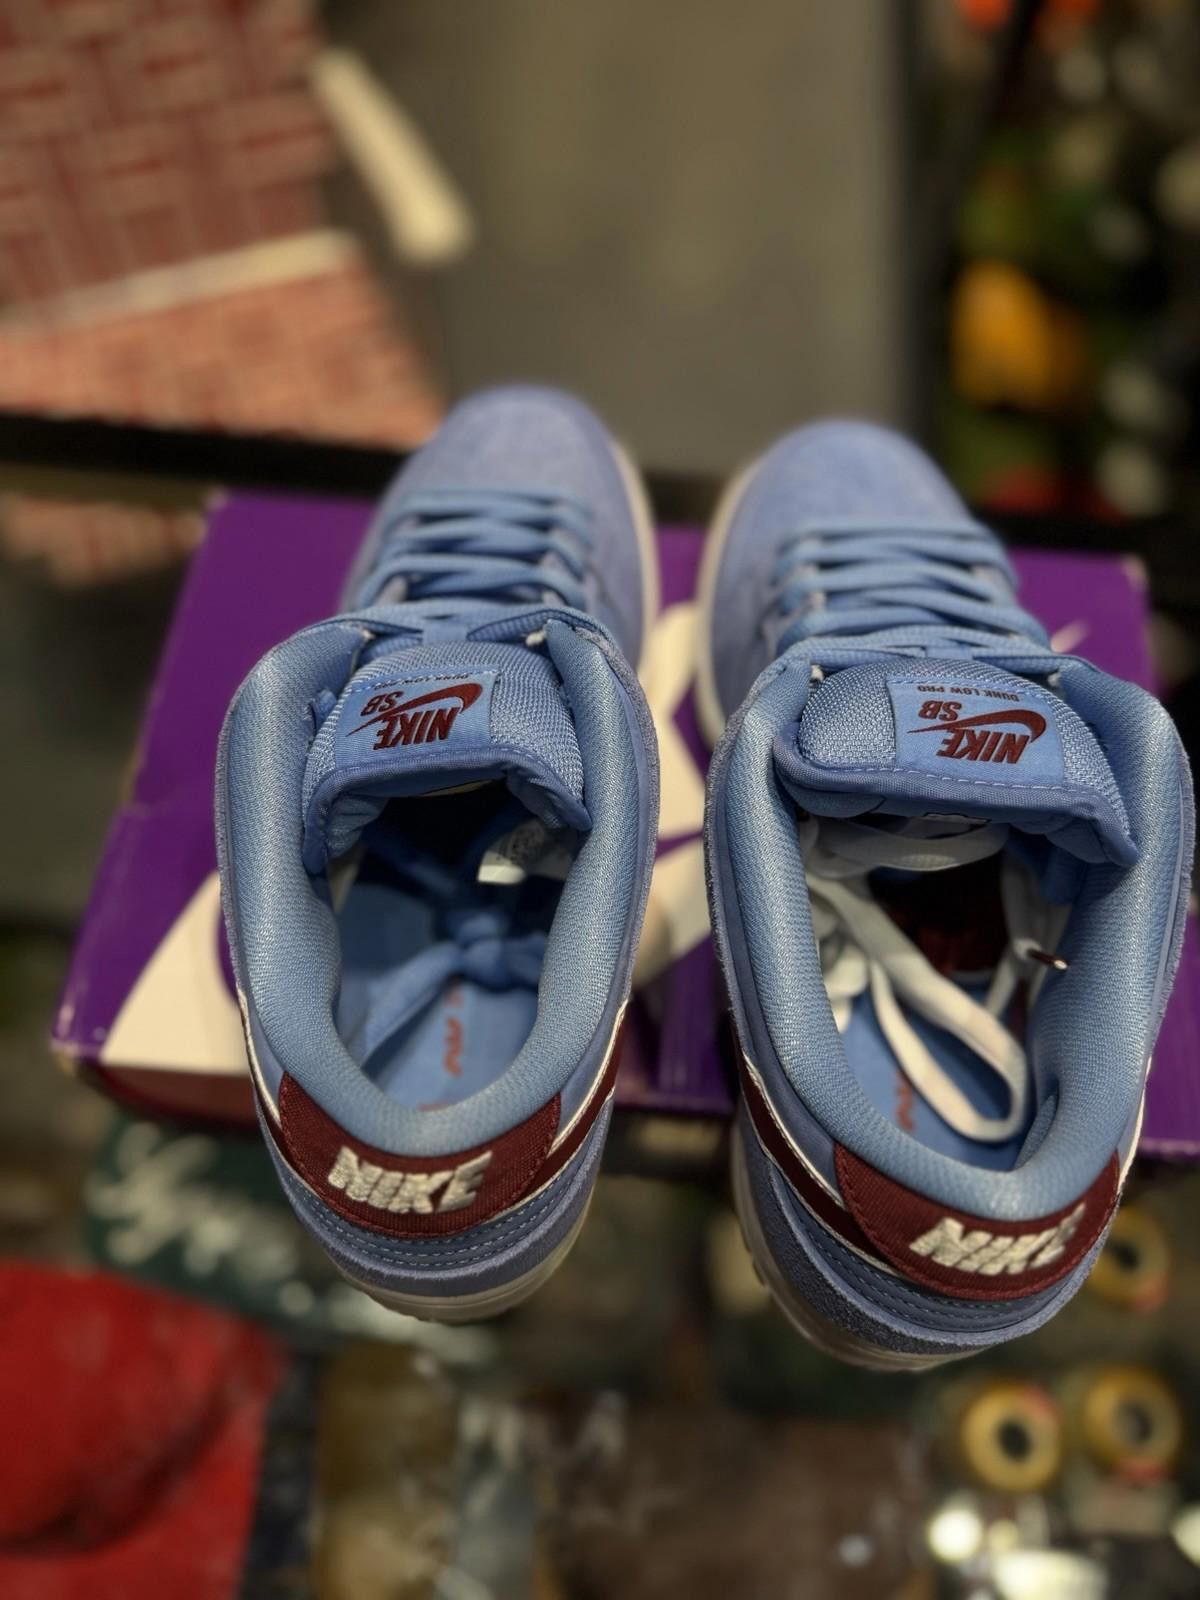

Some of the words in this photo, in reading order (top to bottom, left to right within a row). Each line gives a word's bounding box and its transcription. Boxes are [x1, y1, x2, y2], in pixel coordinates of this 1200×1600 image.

[916, 685, 946, 694] PRO
[950, 687, 980, 696] LOW
[982, 689, 1020, 702] DUNK
[359, 691, 404, 717] SB
[917, 700, 962, 721] SB
[373, 707, 461, 751] NIKE
[936, 729, 1030, 765] NIKE
[328, 1145, 493, 1215] NIKE
[909, 1202, 1086, 1276] NIKE
